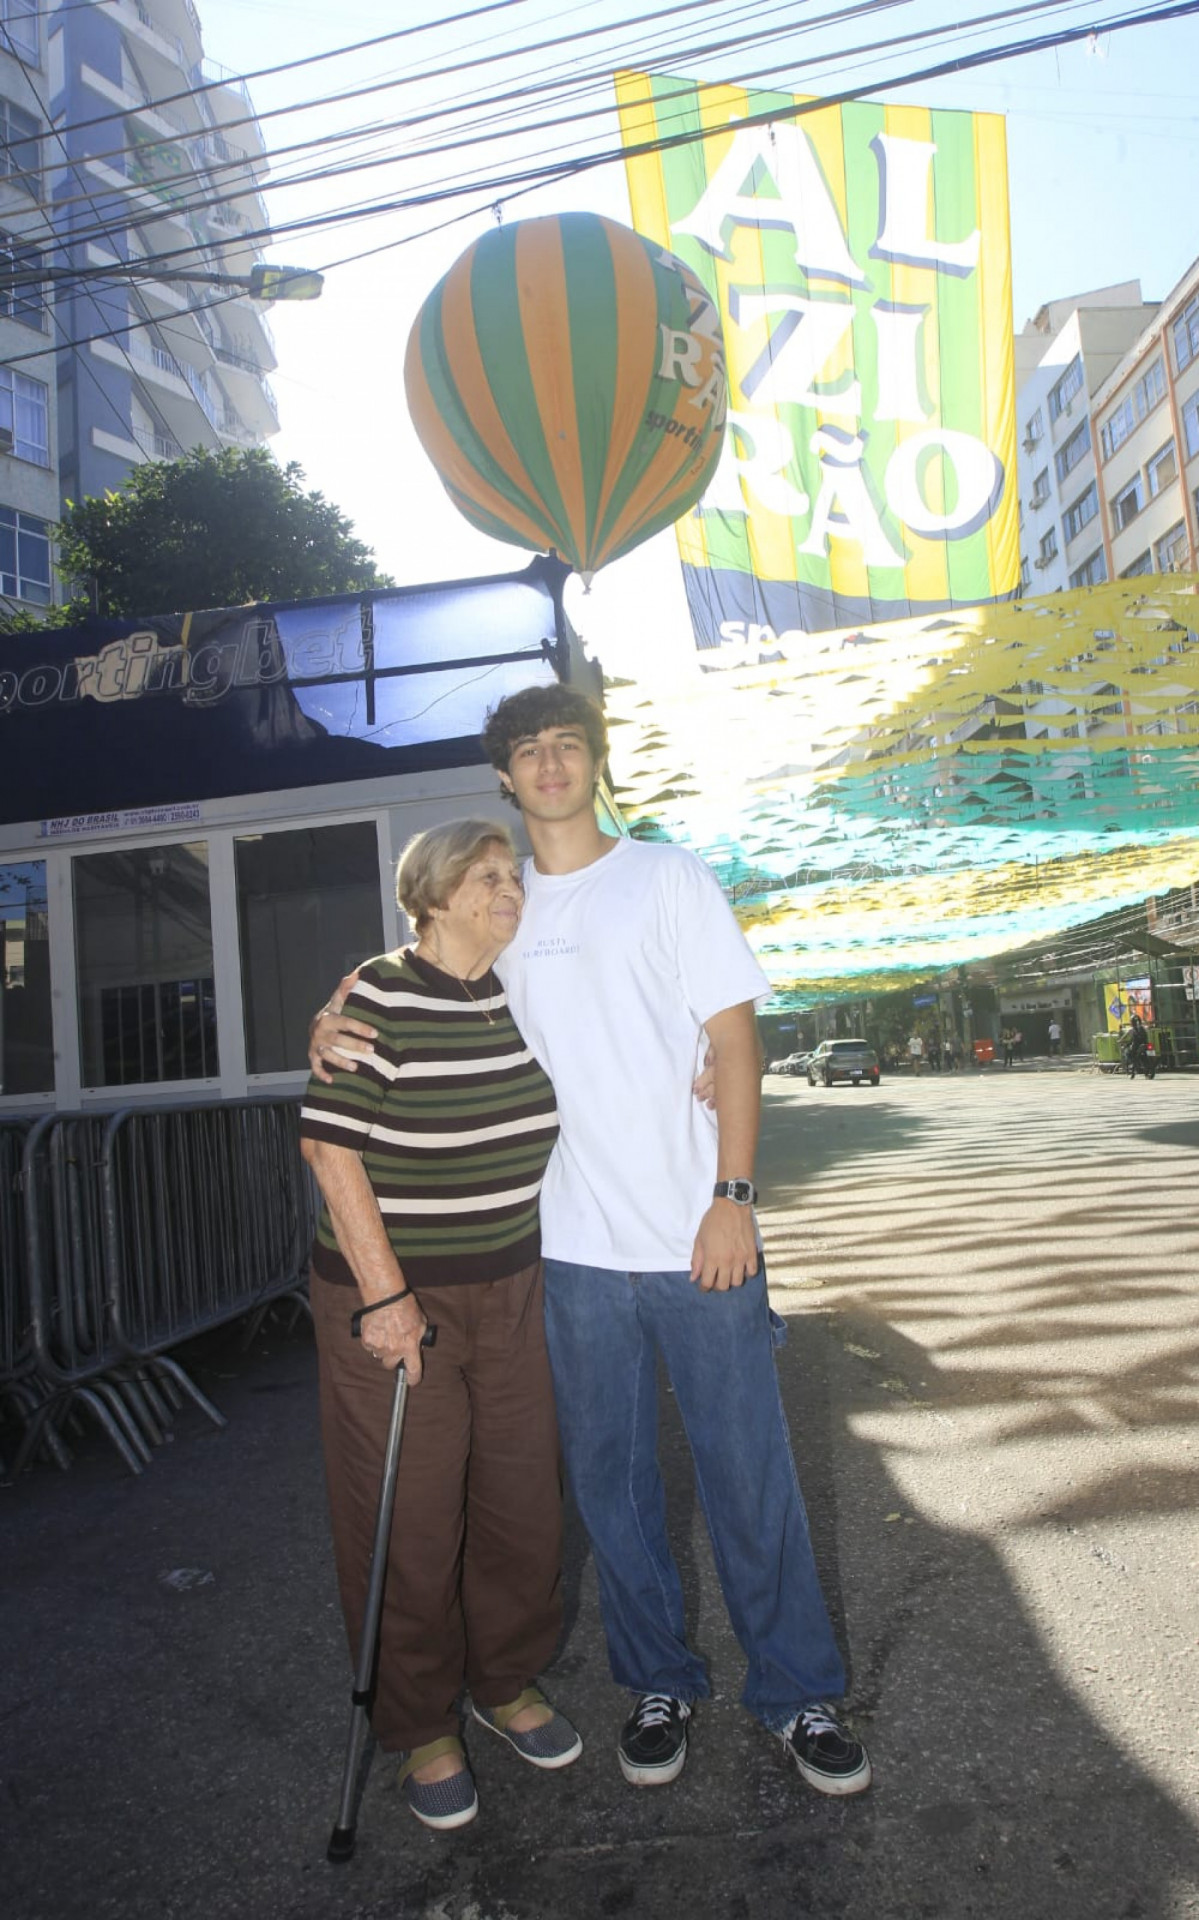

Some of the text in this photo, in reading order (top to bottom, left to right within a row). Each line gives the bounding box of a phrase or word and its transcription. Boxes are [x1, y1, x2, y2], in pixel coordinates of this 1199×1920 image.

[669, 114, 981, 291] AL
[728, 284, 935, 422] ZI
[695, 406, 1005, 568] RÃO
[51, 813, 118, 829] NHJ DO BRASIL
